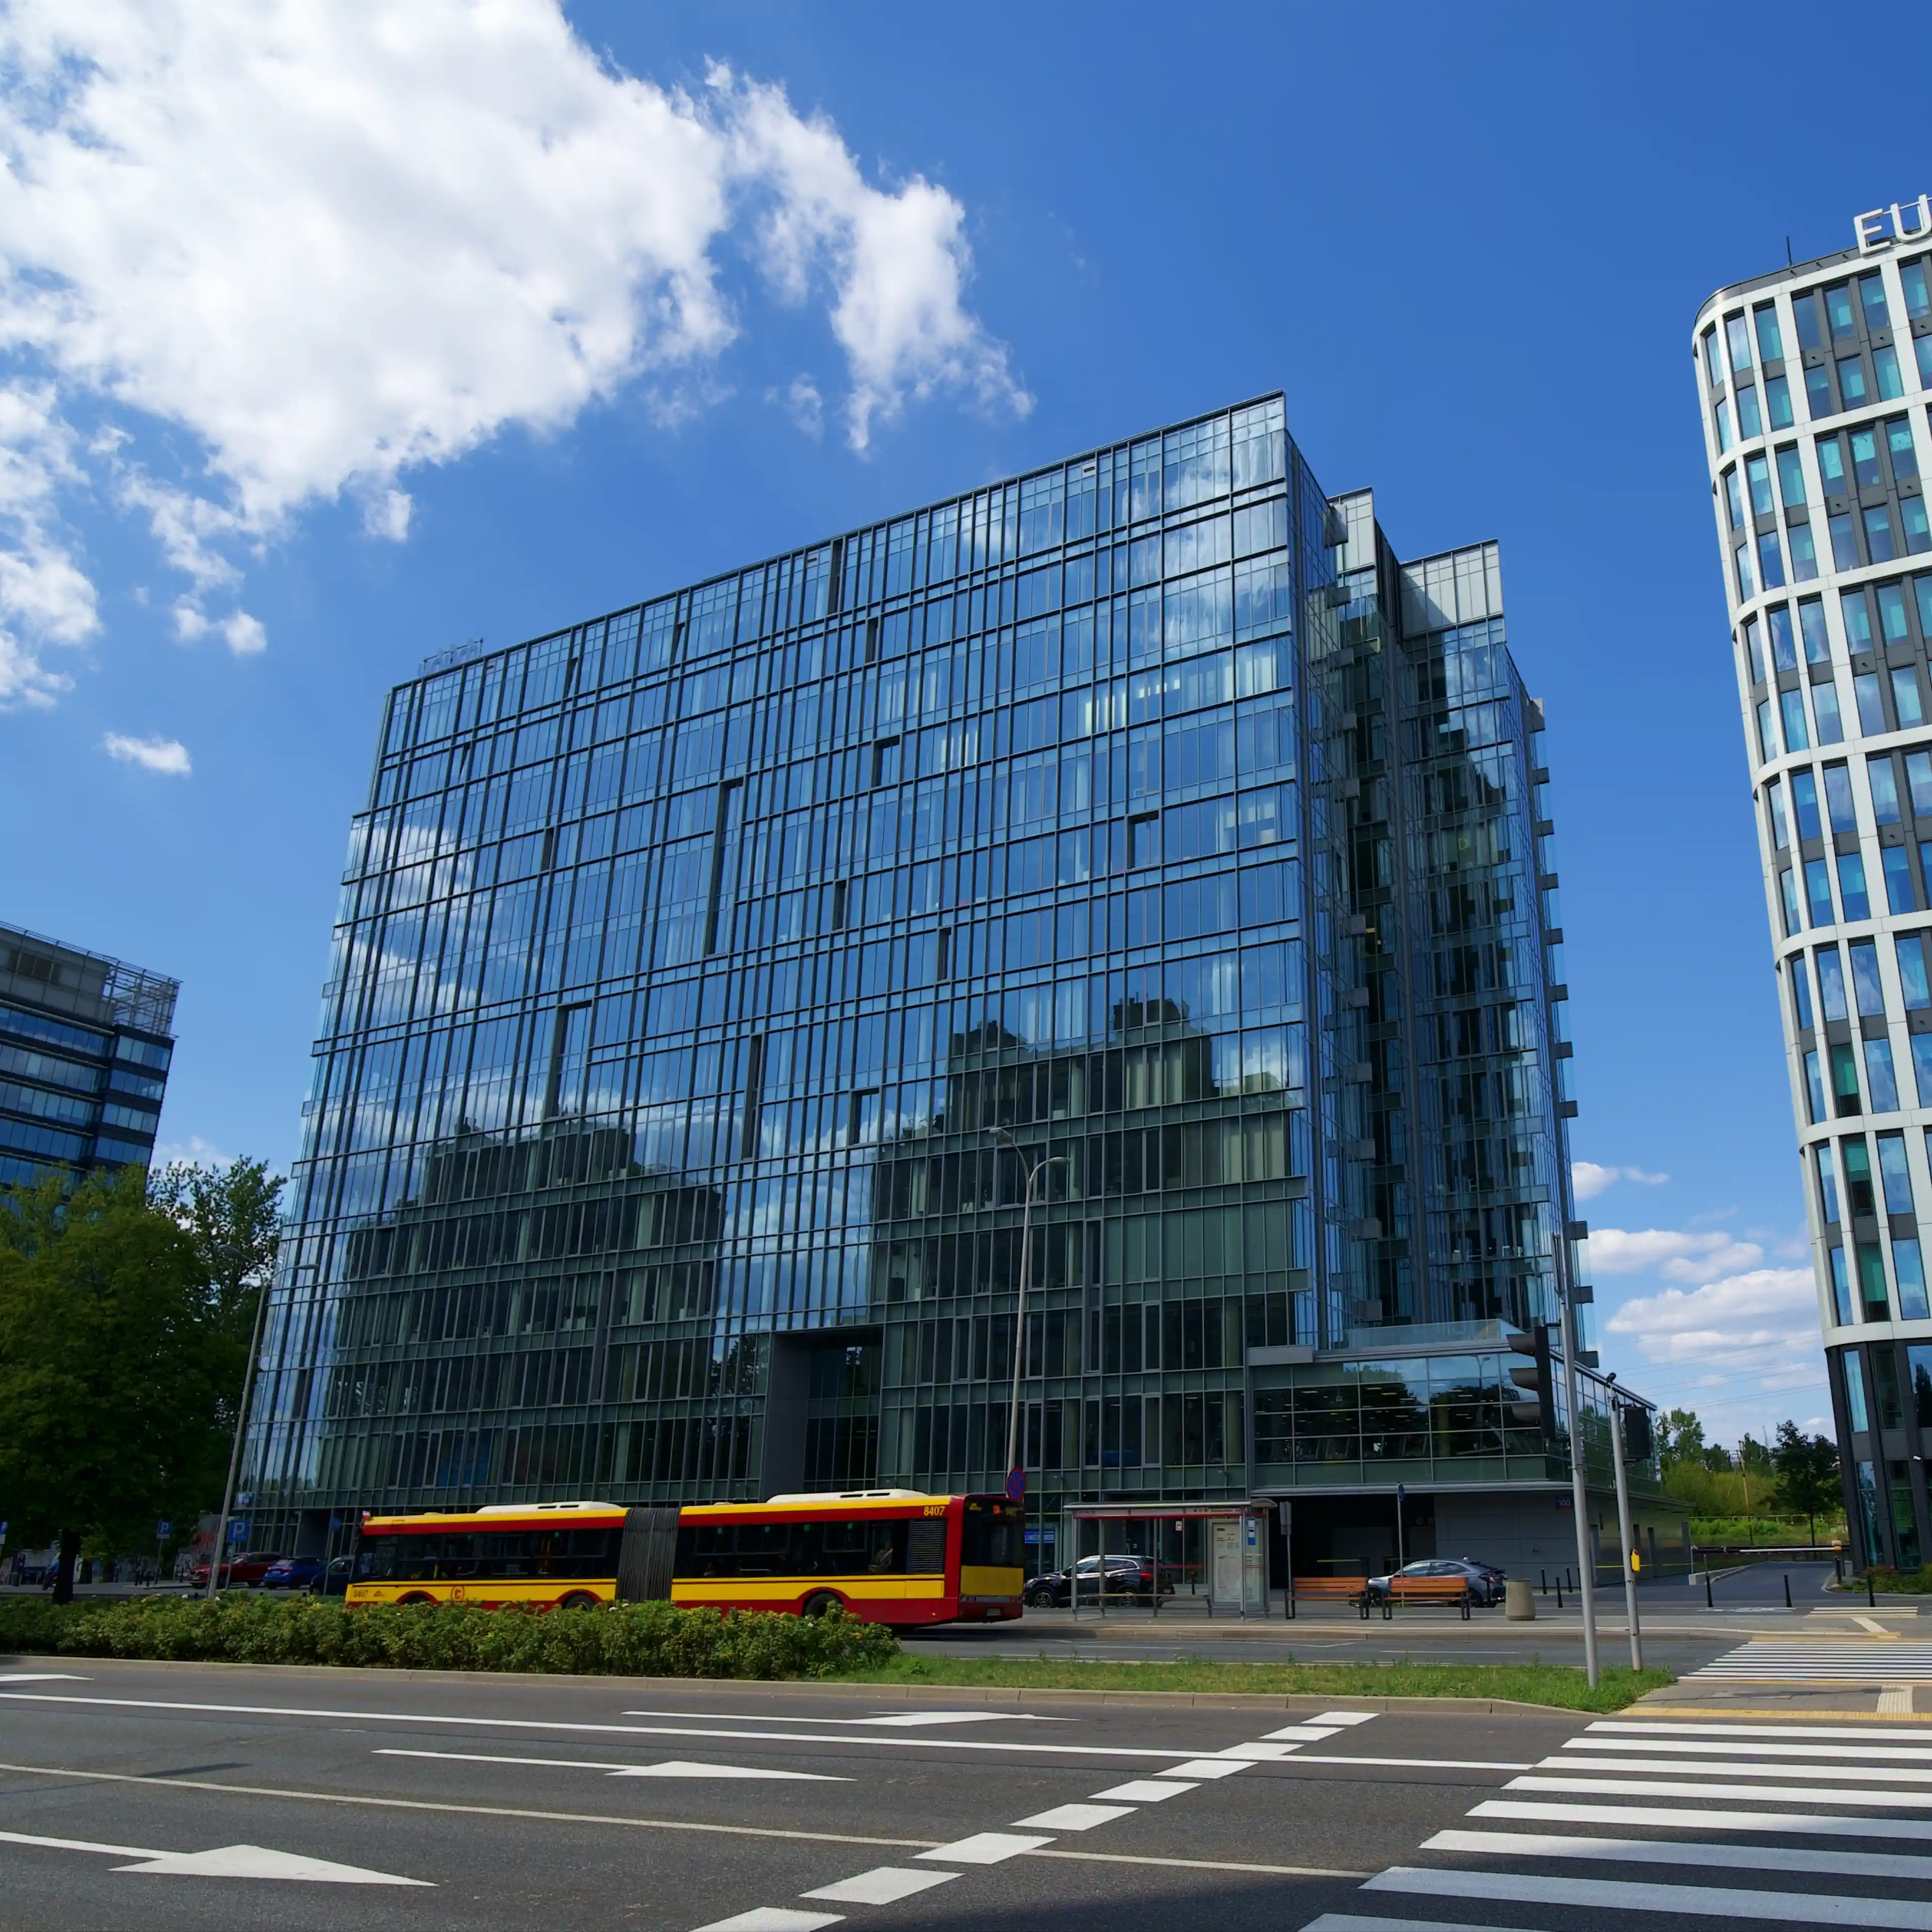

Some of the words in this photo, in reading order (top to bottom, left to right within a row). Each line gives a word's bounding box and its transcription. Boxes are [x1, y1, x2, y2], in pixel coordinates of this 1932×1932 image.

[1854, 194, 1932, 258] EU
[1558, 1499, 1571, 1507] 100
[924, 1506, 946, 1516] 8407
[160, 1522, 169, 1533] P
[233, 1522, 245, 1538] P
